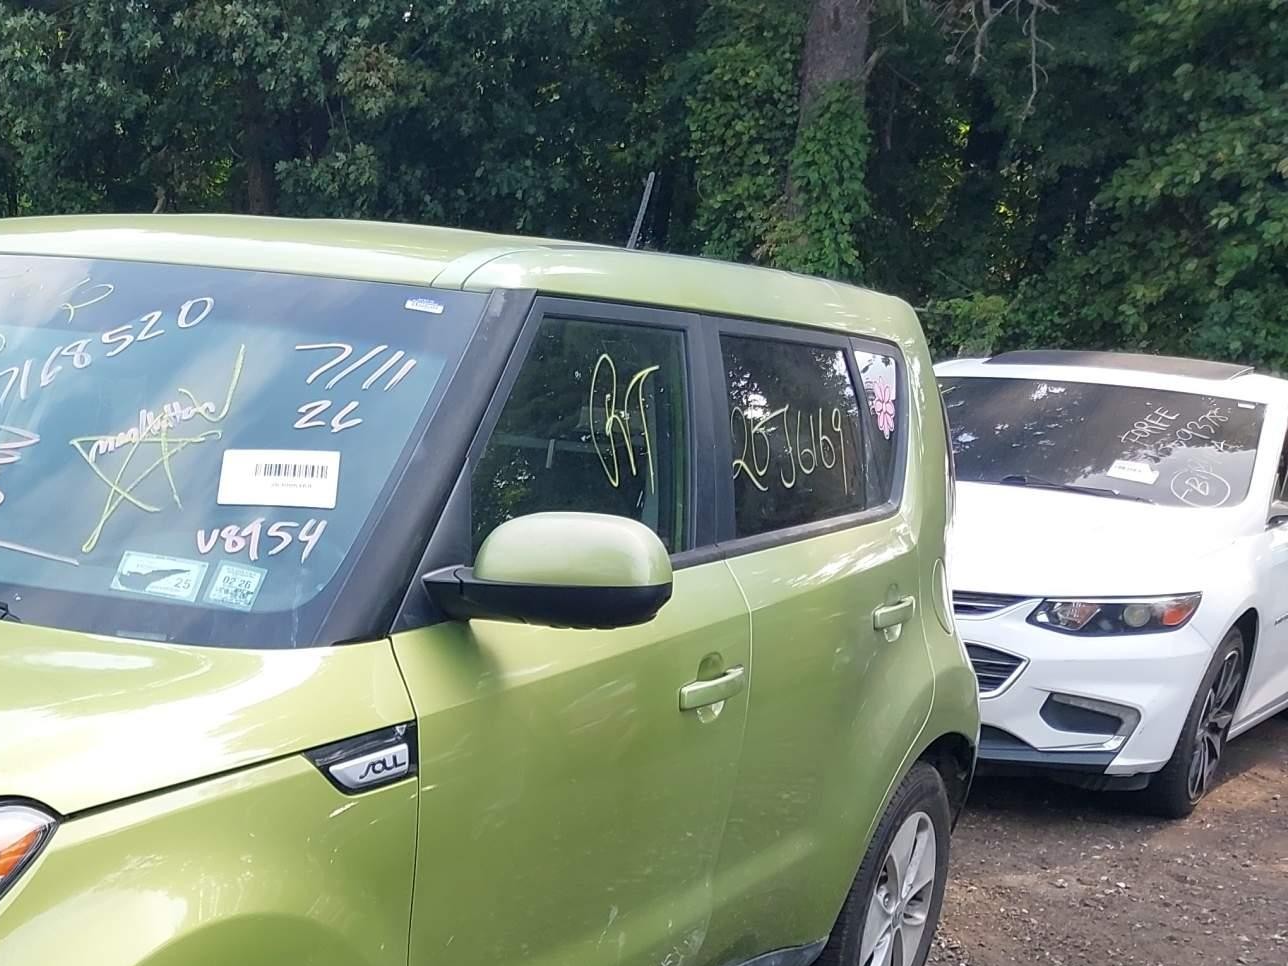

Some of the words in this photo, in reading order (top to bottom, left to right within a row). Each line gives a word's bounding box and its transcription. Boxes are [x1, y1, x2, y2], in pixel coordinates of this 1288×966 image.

[295, 342, 417, 391] 7/11
[293, 399, 363, 433] 26
[173, 576, 193, 591] 25
[358, 754, 407, 780] SOUL
